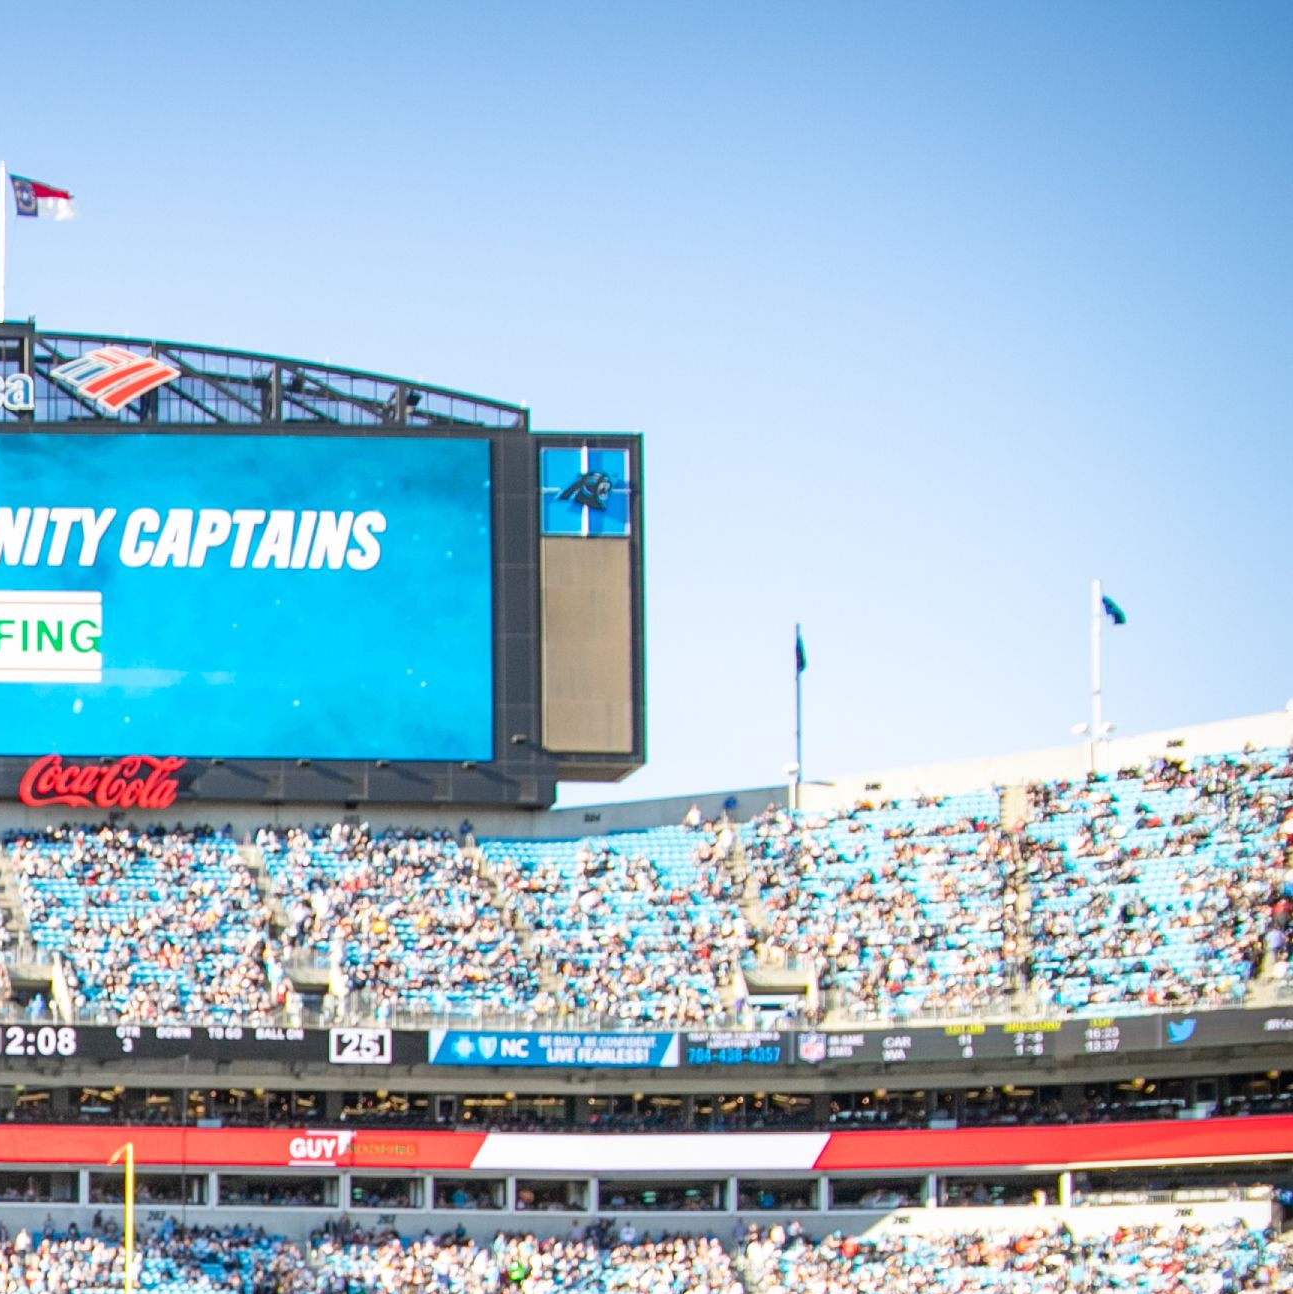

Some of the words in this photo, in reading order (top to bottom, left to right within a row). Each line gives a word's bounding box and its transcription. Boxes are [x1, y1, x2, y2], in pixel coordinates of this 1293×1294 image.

[119, 506, 387, 571] CAPTAINS
[19, 753, 186, 809] Coca-Cola
[122, 1038, 133, 1052] 3
[340, 1033, 381, 1059] 25
[501, 1038, 529, 1058] NC
[882, 1036, 911, 1049] CAR
[289, 1138, 336, 1158] GUY
